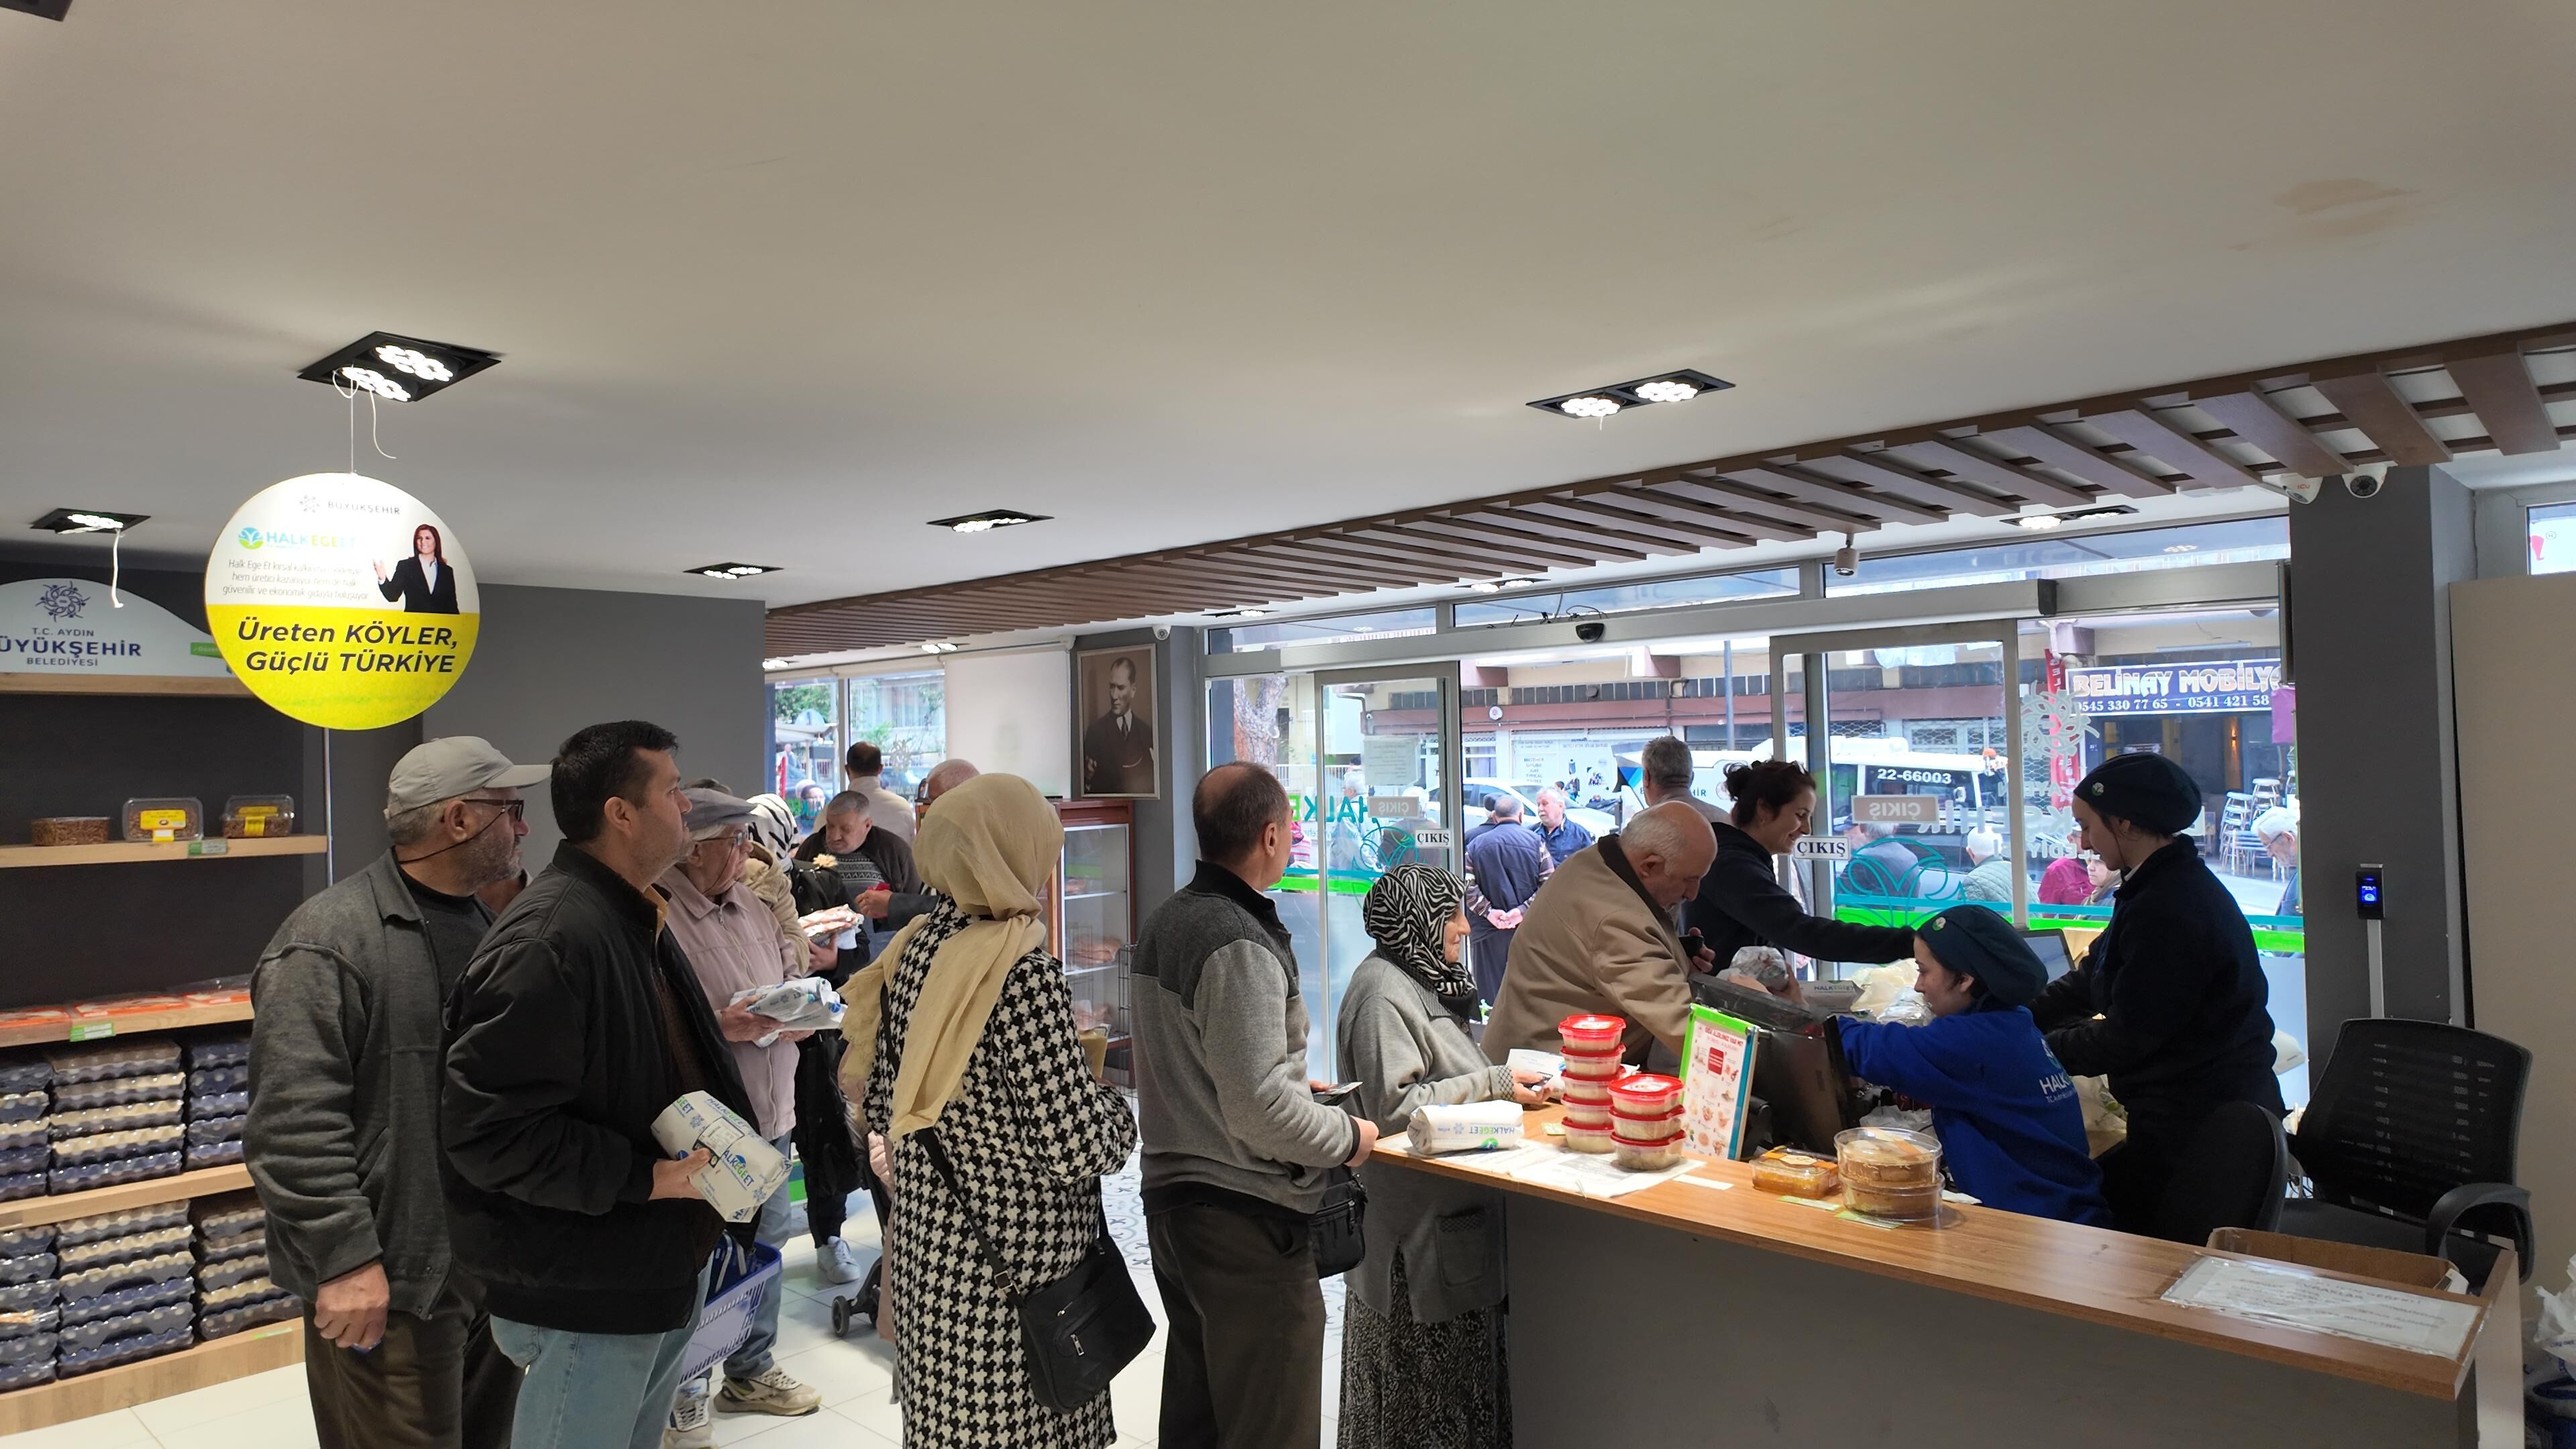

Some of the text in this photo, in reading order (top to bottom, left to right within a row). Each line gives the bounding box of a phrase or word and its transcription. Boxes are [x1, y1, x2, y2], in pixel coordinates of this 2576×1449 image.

[229, 559, 245, 569] Halk
[248, 561, 262, 572] Ege
[264, 561, 271, 570] Et
[273, 562, 292, 571] kırsal
[232, 572, 250, 581] hem
[252, 573, 275, 582] üretici
[223, 584, 255, 595] güvenilir
[269, 586, 305, 596] ekonomik
[32, 627, 95, 637] T.C. AYDIN
[238, 616, 458, 649] Üreten KÖYLER,
[0, 635, 142, 658] ÜYÜKŞEHİR
[27, 657, 98, 667] BELEDİYESİ
[246, 649, 455, 675] Güçlü TÜRKİYE
[2073, 668, 2173, 697] BELİNAY
[2107, 700, 2130, 710] 330
[2134, 699, 2148, 710] 77
[2152, 698, 2167, 708] 65
[2188, 696, 2218, 708] 0541
[2223, 695, 2247, 706] 421
[2253, 694, 2269, 706] 58
[1877, 768, 1952, 784] 22-66003
[1417, 833, 1450, 847] ÇIKIŞ
[1797, 841, 1845, 857] ÇIKIŞ
[1469, 1126, 1515, 1135] HALKEGEET
[723, 1148, 755, 1187] ALKEGEET
